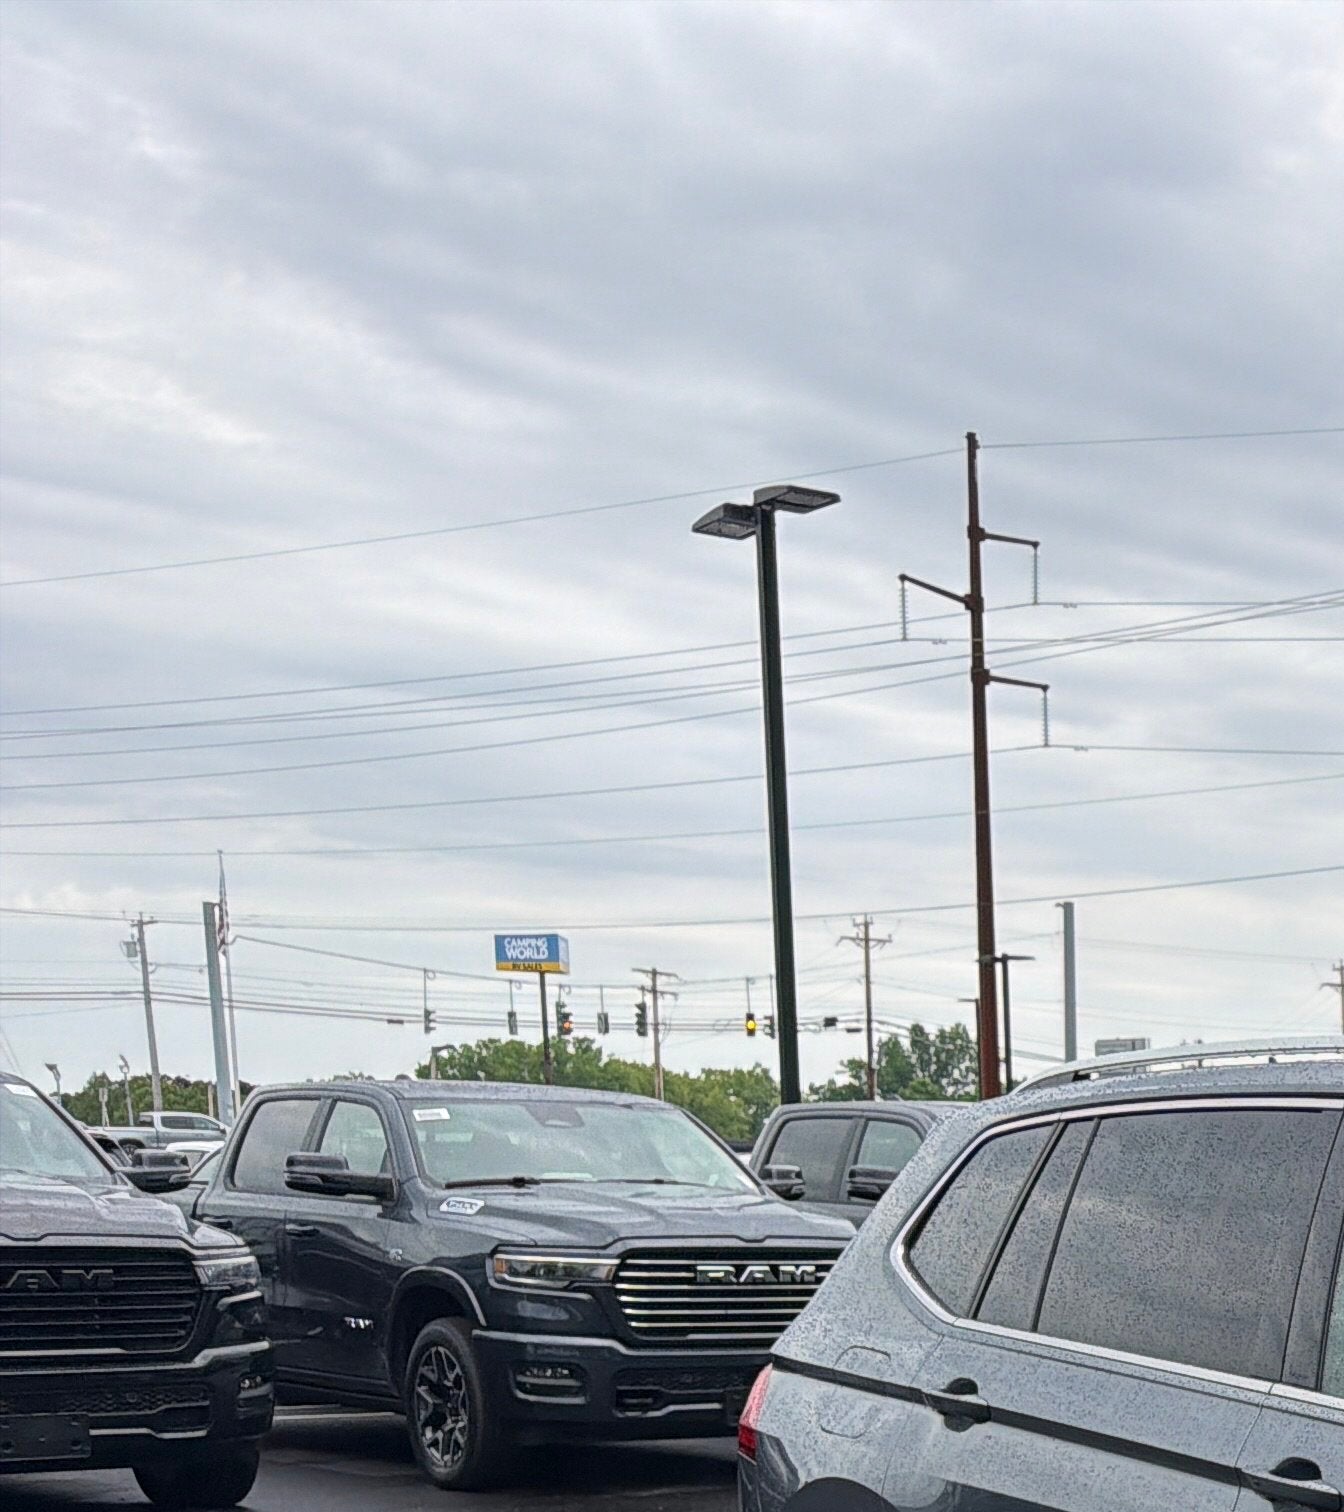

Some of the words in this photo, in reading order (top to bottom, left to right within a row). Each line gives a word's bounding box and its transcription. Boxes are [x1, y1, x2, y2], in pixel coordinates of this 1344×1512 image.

[504, 937, 547, 948] CAMPING
[506, 947, 549, 960] WORLD
[2, 1269, 114, 1289] AM
[696, 1265, 816, 1283] RAM
